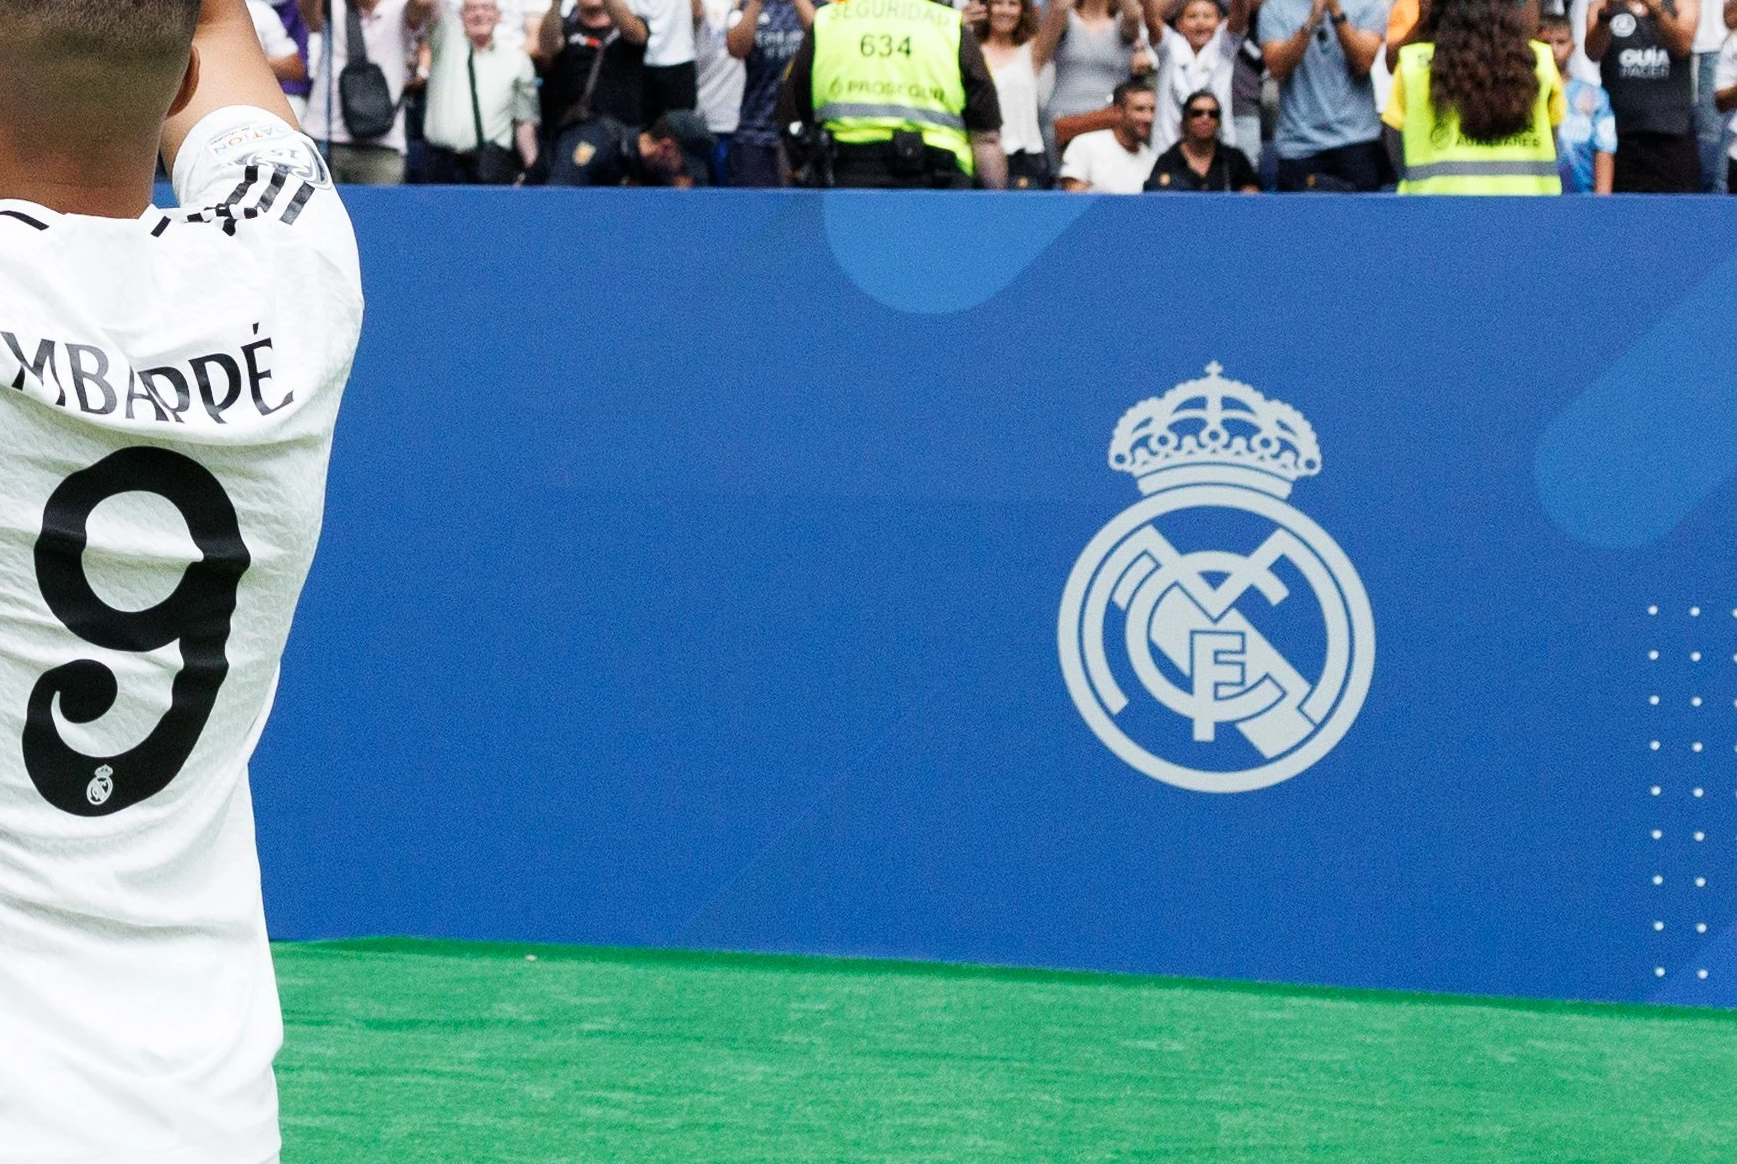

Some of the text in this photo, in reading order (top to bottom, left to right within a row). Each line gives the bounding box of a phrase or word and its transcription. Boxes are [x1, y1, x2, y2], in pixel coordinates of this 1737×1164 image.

[860, 34, 912, 58] 634
[0, 322, 295, 424] MBAPPÉ
[22, 446, 251, 817] 9
